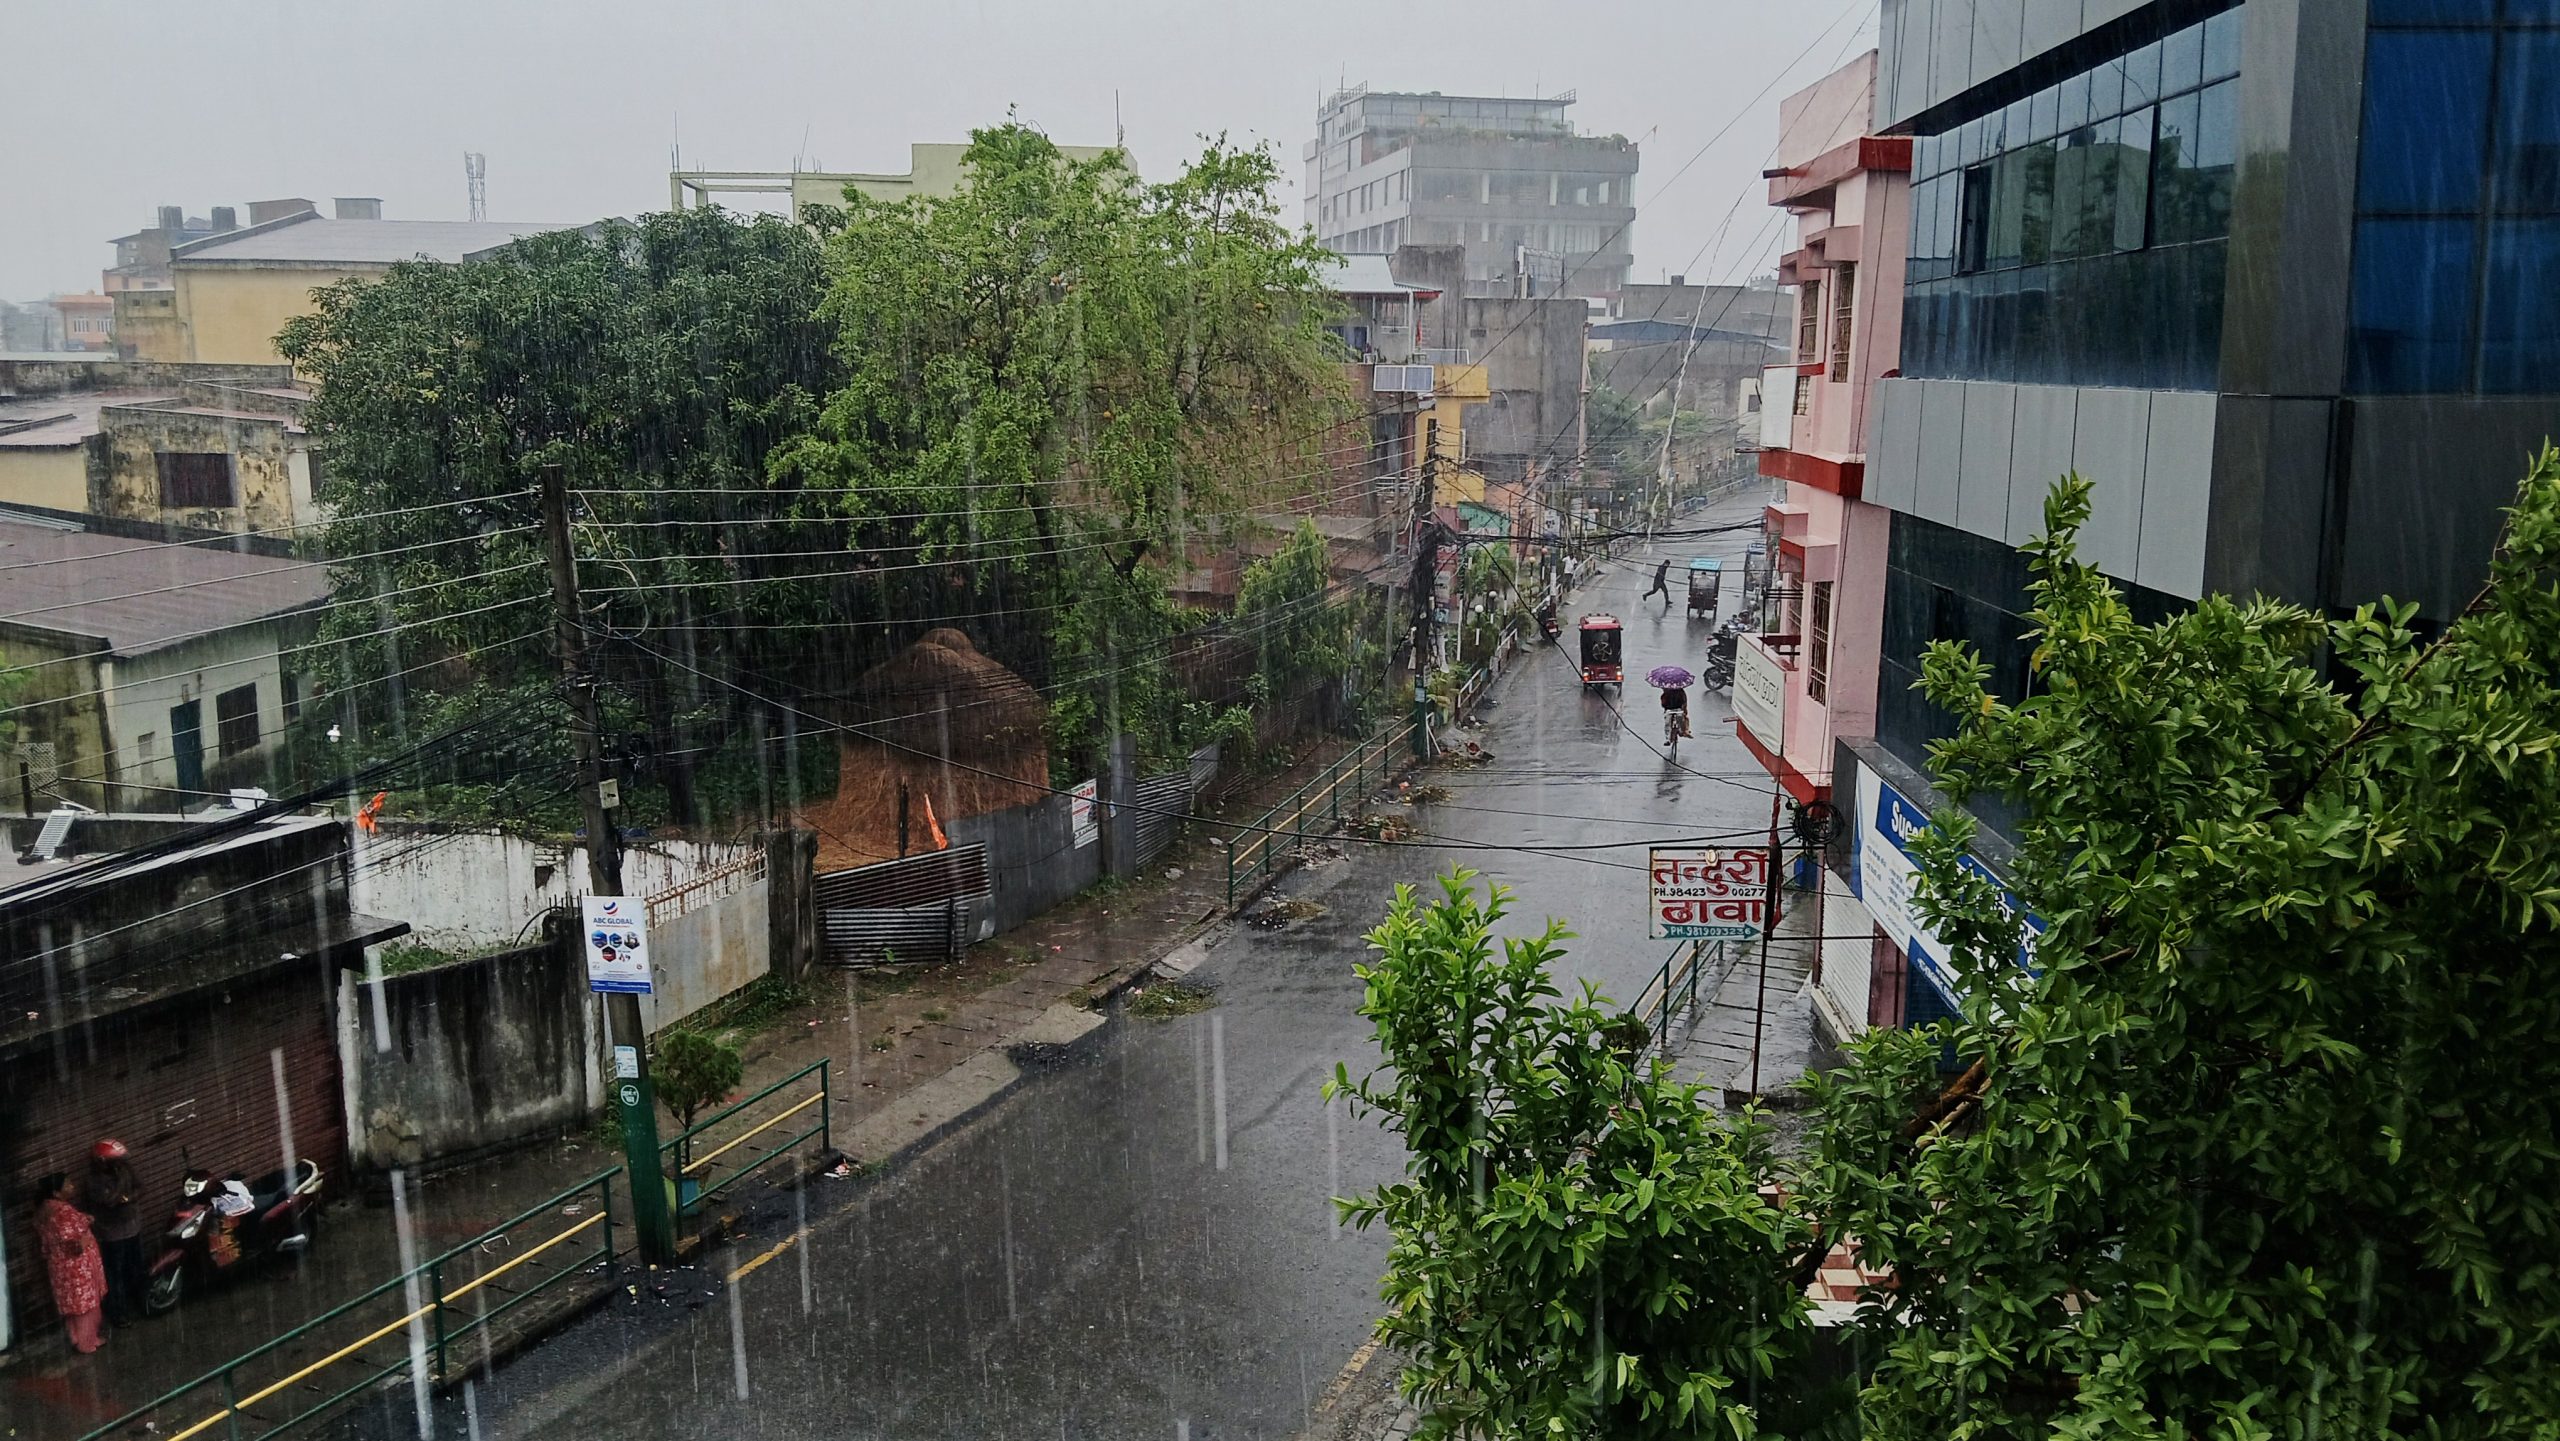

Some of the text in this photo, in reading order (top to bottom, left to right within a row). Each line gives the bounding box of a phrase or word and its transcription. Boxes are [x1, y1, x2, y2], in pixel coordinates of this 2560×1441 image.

[1653, 850, 1768, 896] तन्दुरी
[1731, 888, 1766, 897] 00277
[1659, 899, 1766, 924] ढावा
[607, 917, 634, 925] GLOBAL
